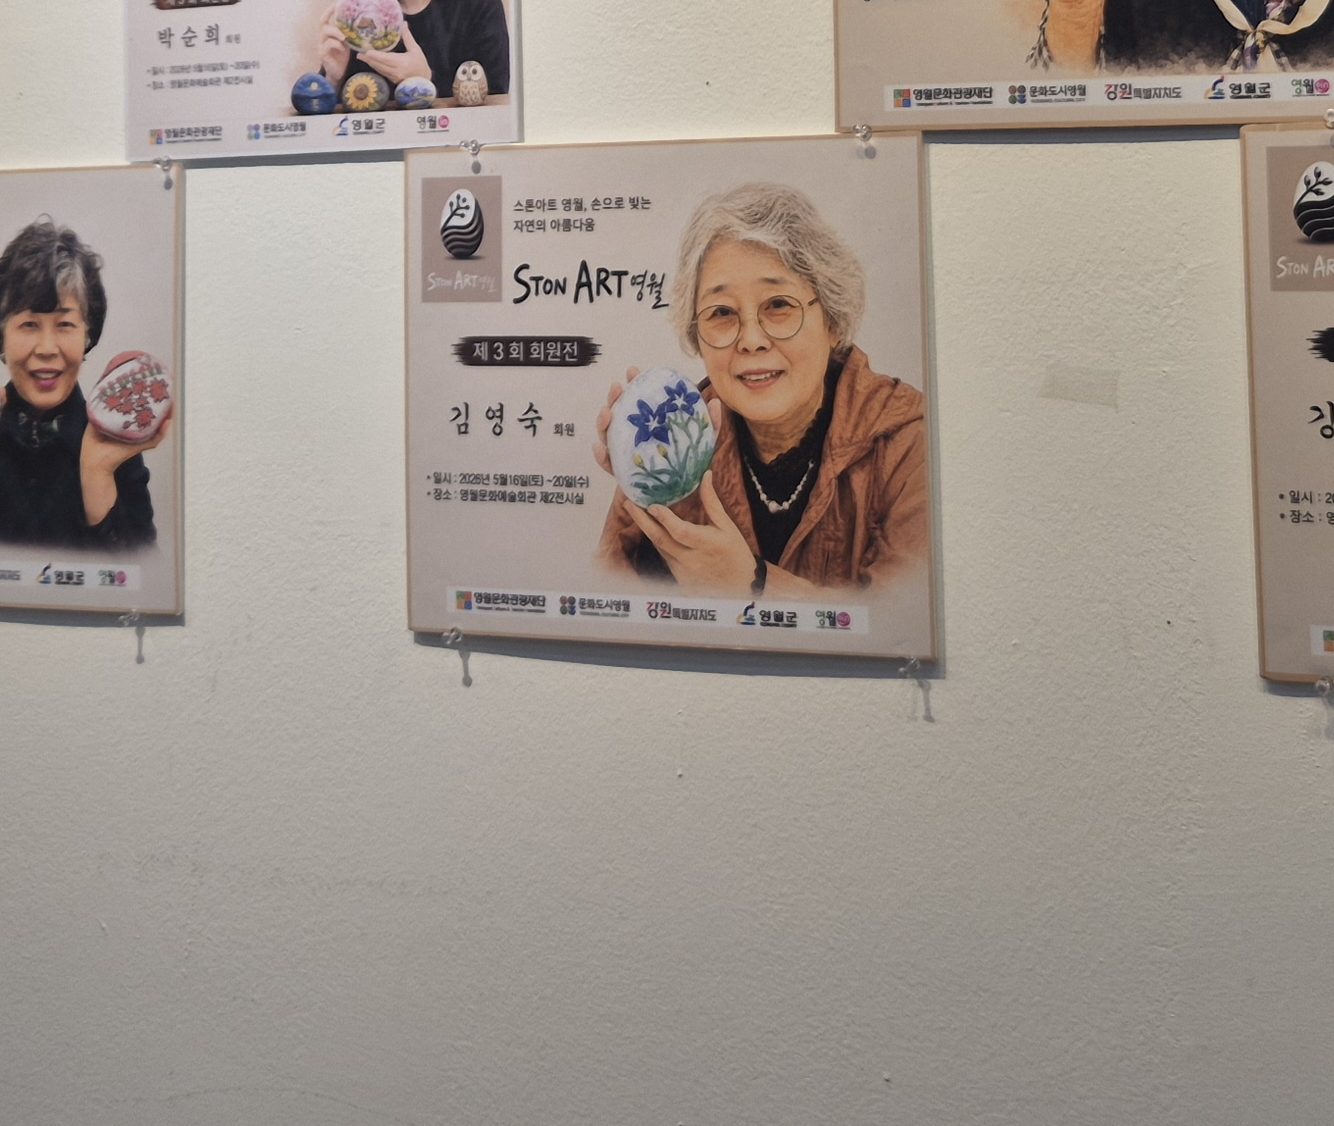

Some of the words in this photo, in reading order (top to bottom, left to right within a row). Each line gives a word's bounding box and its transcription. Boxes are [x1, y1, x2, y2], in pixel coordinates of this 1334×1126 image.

[913, 87, 992, 100] 영월문화관광재단
[1029, 84, 1086, 98] 문화도시영월
[1229, 82, 1270, 95] 영월군
[513, 198, 557, 212] 스톤아트
[562, 198, 587, 212] 영월,
[591, 197, 625, 210] 손으로
[513, 220, 546, 232] 자연의
[550, 218, 595, 232] 아름다움
[1276, 256, 1308, 277] STON
[513, 264, 566, 304] STON
[529, 341, 578, 361] 회원전
[554, 423, 574, 436] 회원
[460, 490, 536, 503] 영월문화예술회관
[540, 492, 584, 504] 제2전시실
[579, 598, 630, 612] 문화도시영월
[759, 610, 797, 623] 영월군
